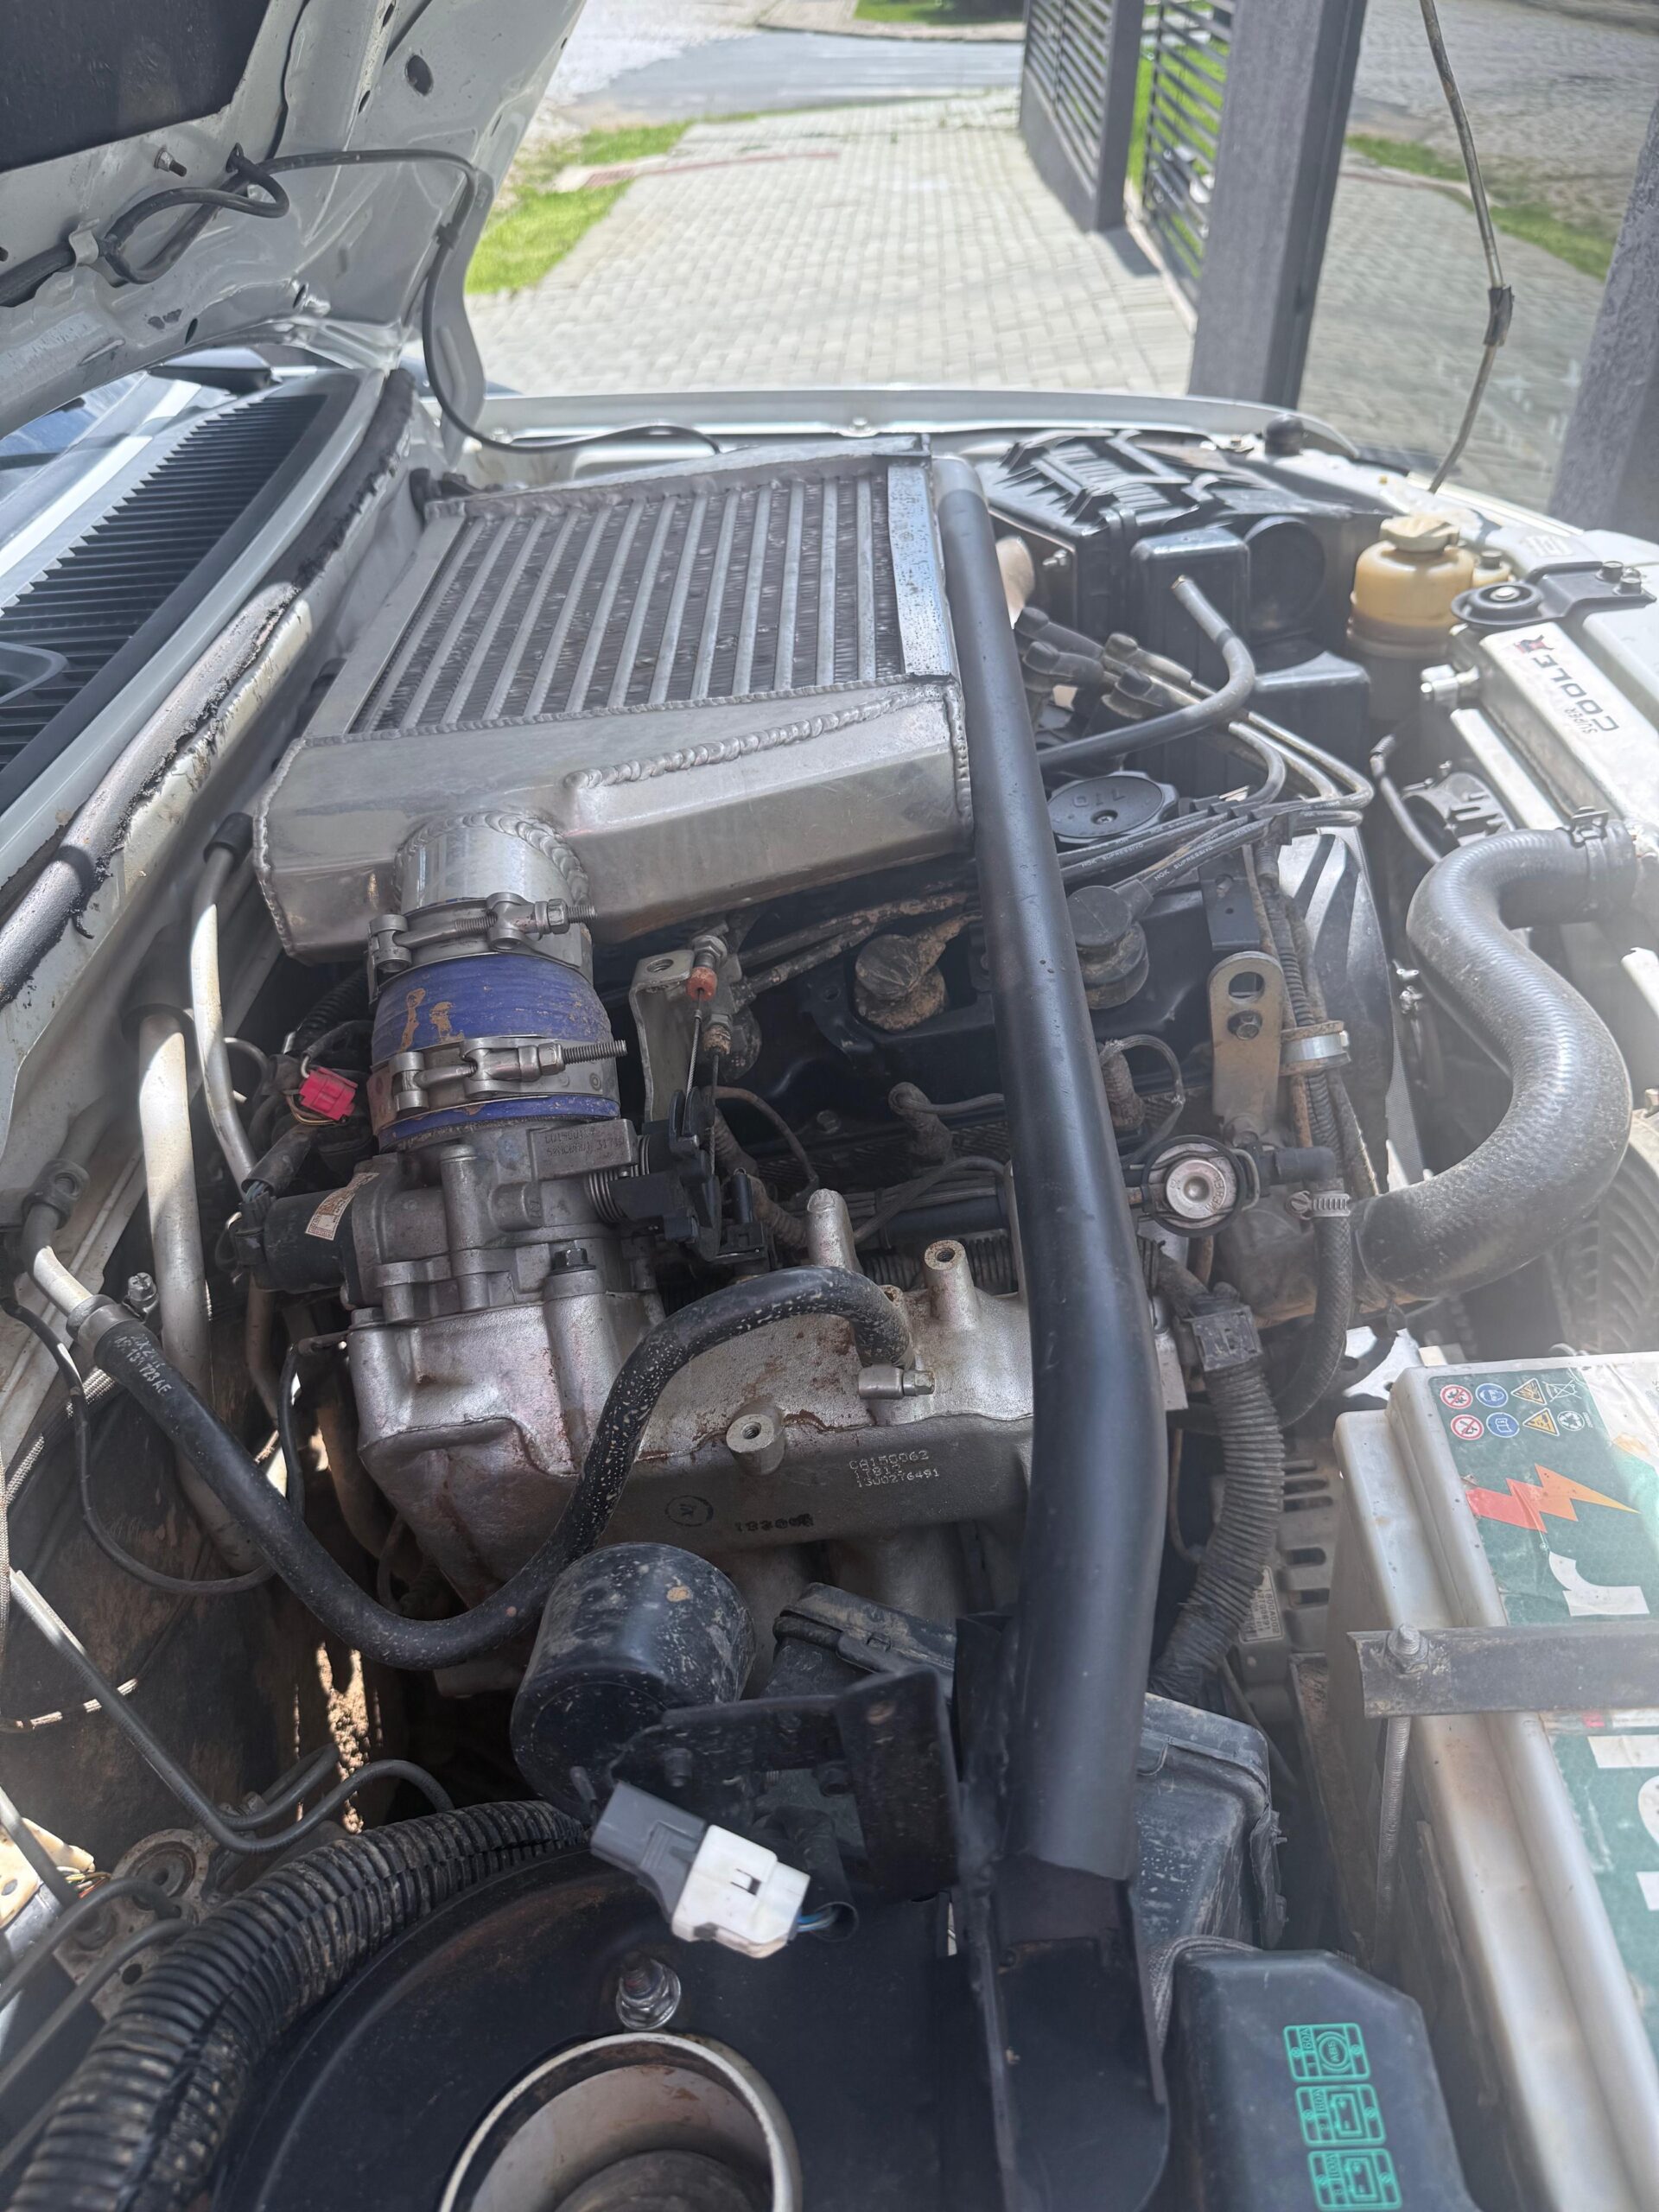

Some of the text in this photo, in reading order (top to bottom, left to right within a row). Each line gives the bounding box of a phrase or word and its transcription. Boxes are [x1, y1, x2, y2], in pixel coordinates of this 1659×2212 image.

[1564, 708, 1598, 734] SUPER
[1072, 788, 1126, 807] OIL
[1173, 845, 1214, 869] SUPRESSIVO
[849, 1450, 930, 1471] CA150062
[1326, 2040, 1341, 2063] ABS
